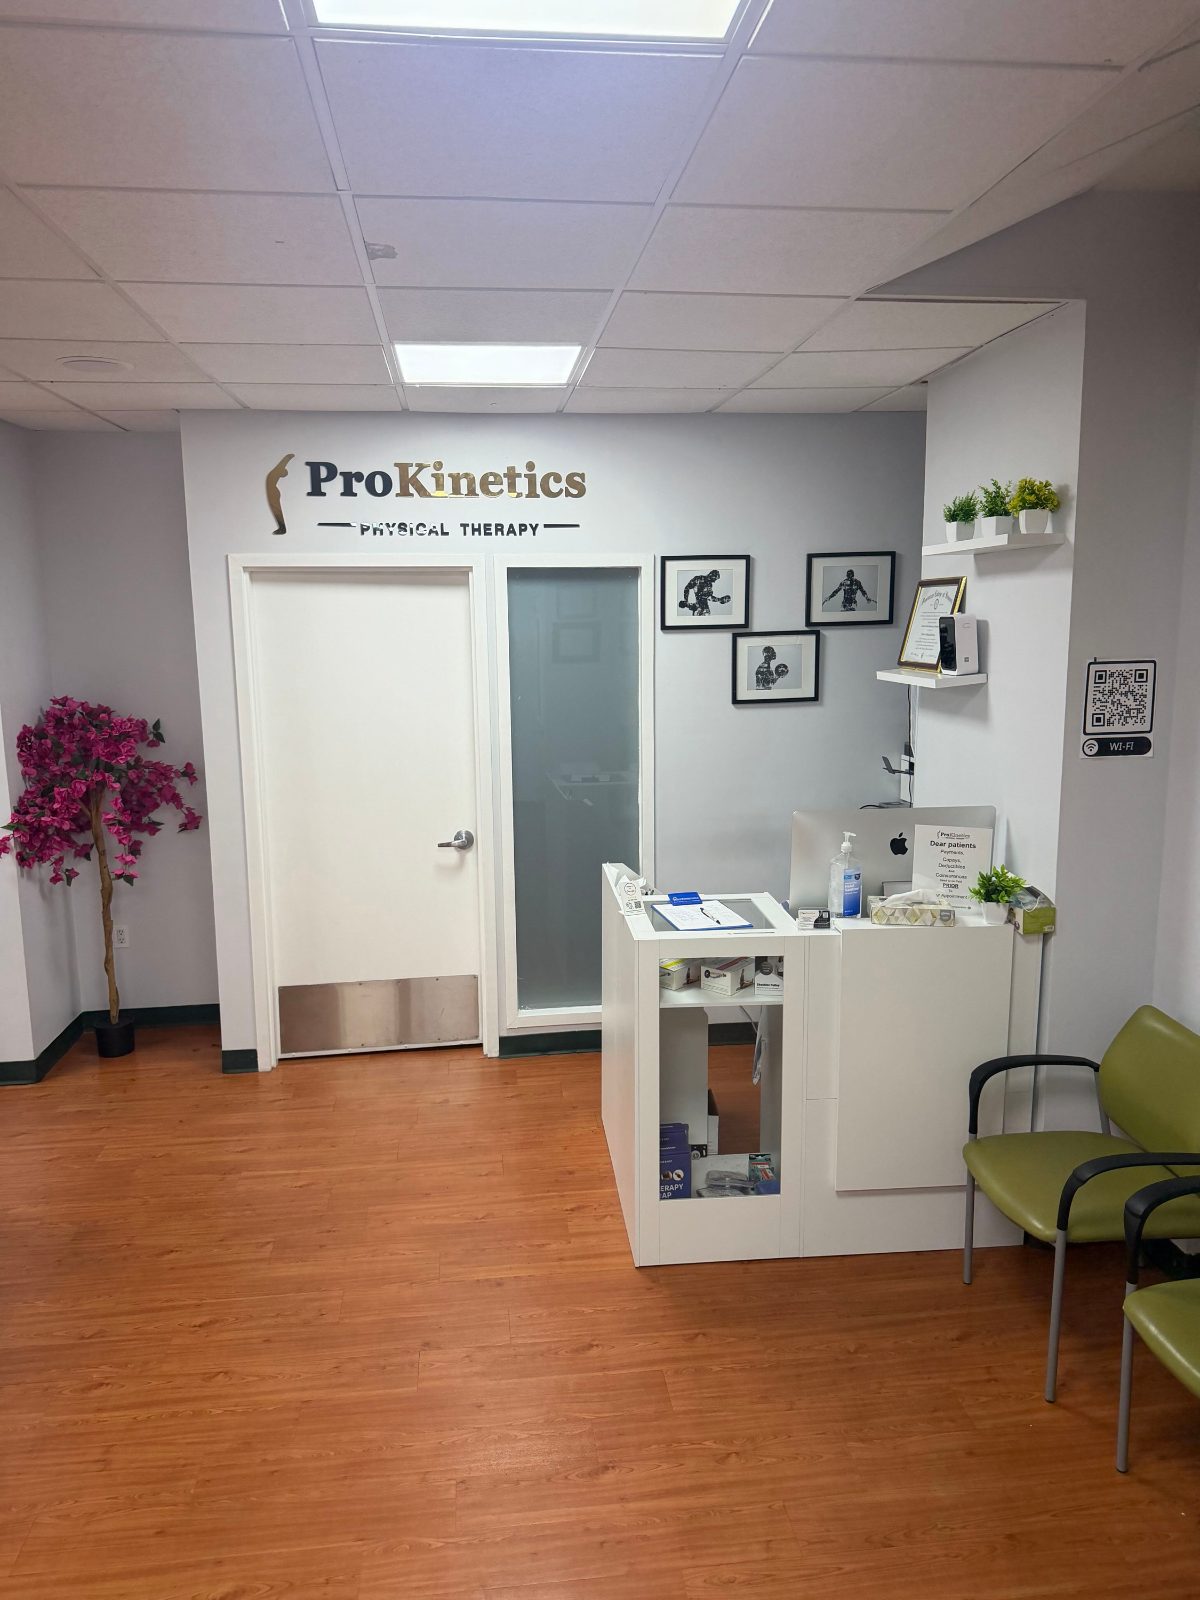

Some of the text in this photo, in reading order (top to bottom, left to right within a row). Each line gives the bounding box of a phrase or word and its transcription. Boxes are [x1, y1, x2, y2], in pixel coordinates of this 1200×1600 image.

[305, 460, 587, 499] ProKinetics
[360, 523, 539, 536] PHYSICAL THERAPY
[1109, 742, 1134, 750] WI-FI
[660, 1184, 684, 1192] ERAPY
